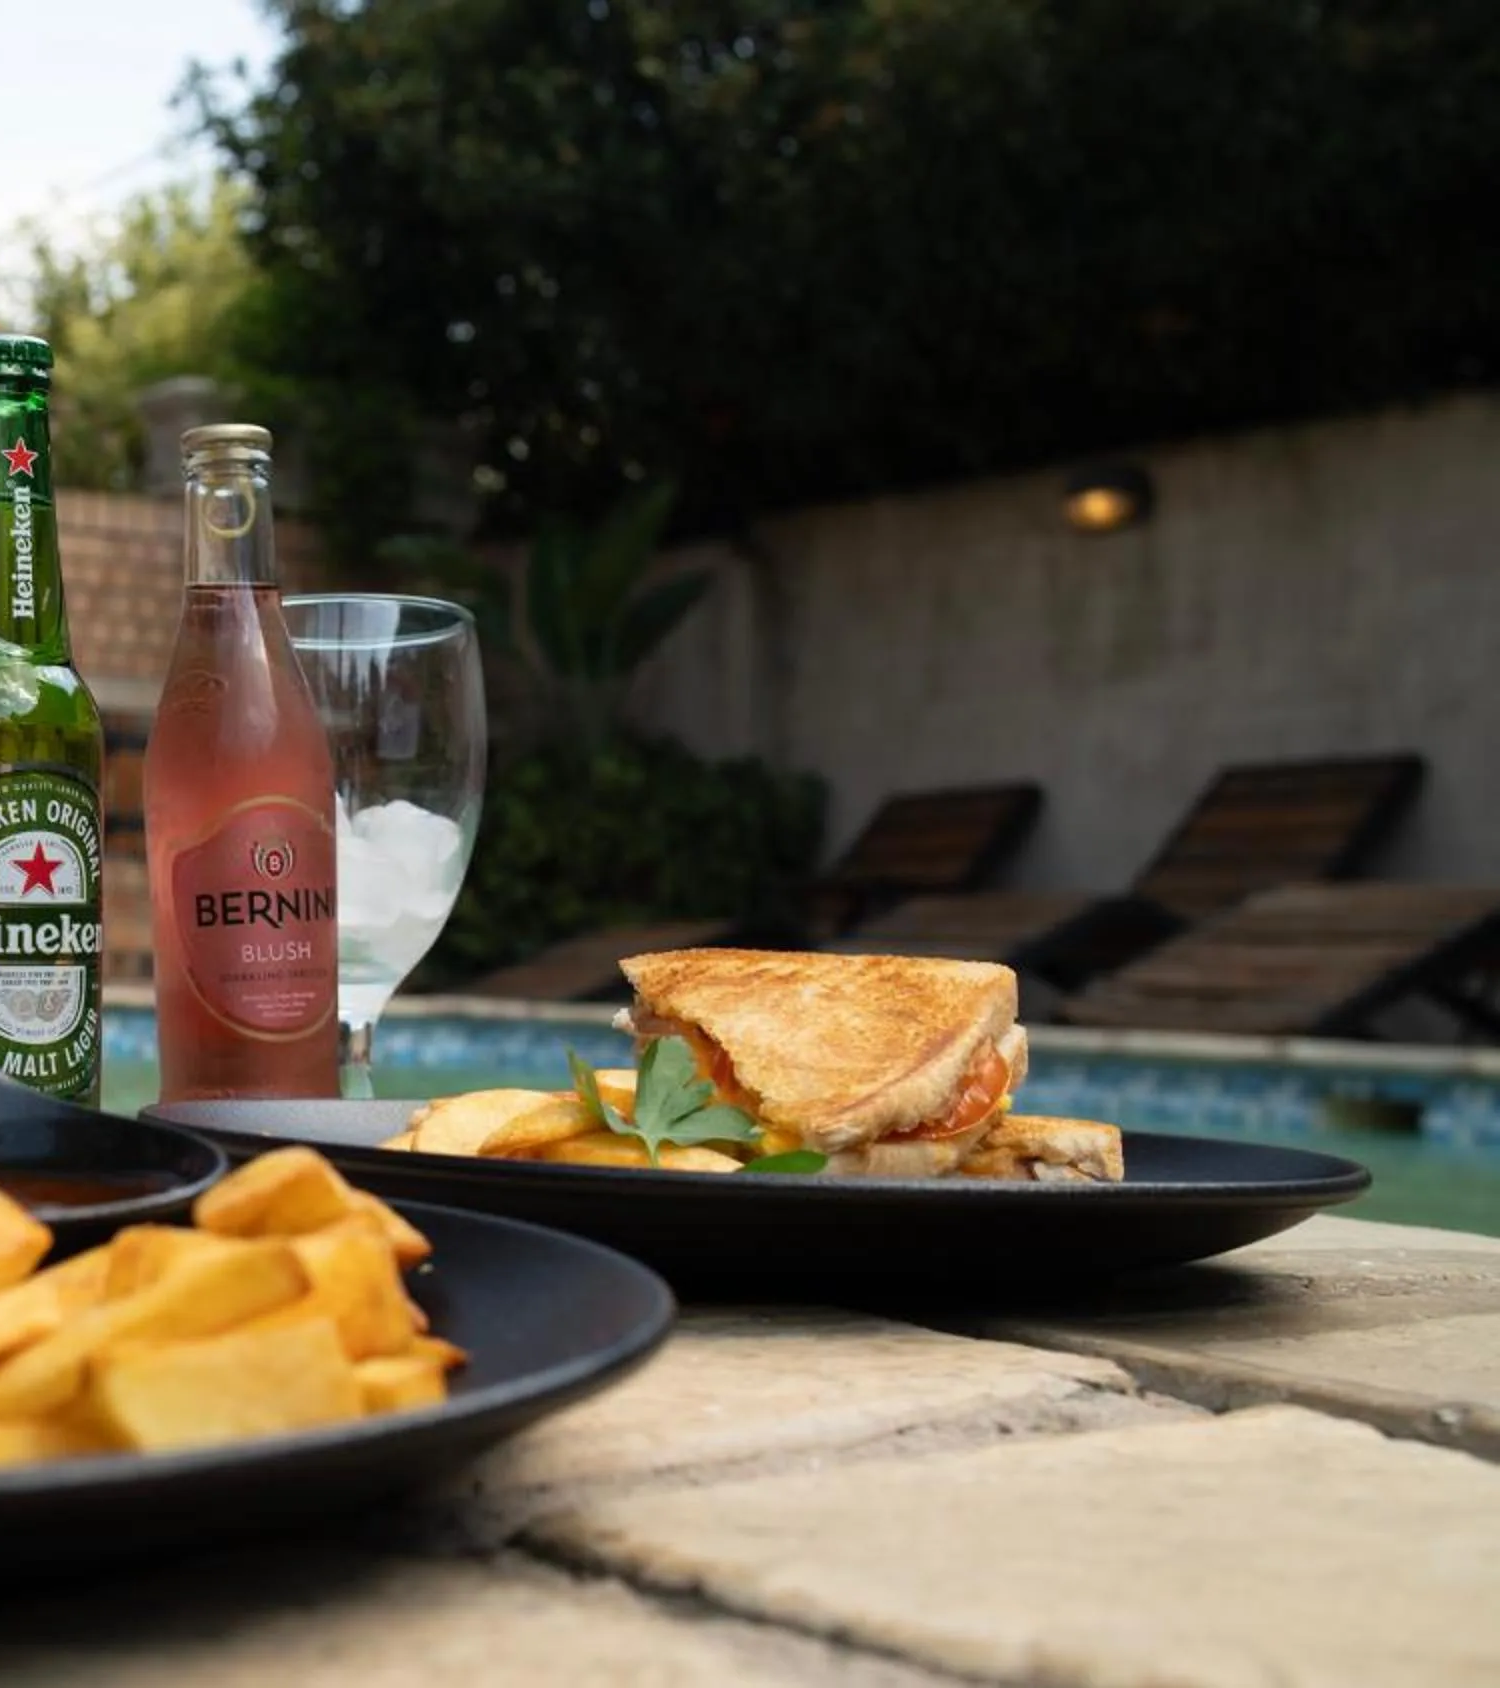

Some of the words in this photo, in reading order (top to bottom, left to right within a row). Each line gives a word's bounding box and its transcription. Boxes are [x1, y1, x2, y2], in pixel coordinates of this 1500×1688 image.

[10, 486, 35, 620] Heineken
[47, 800, 100, 883] ORIGINAL
[241, 941, 311, 963] BLUSH
[2, 1050, 58, 1077] MALT
[65, 1008, 98, 1069] LAGER
